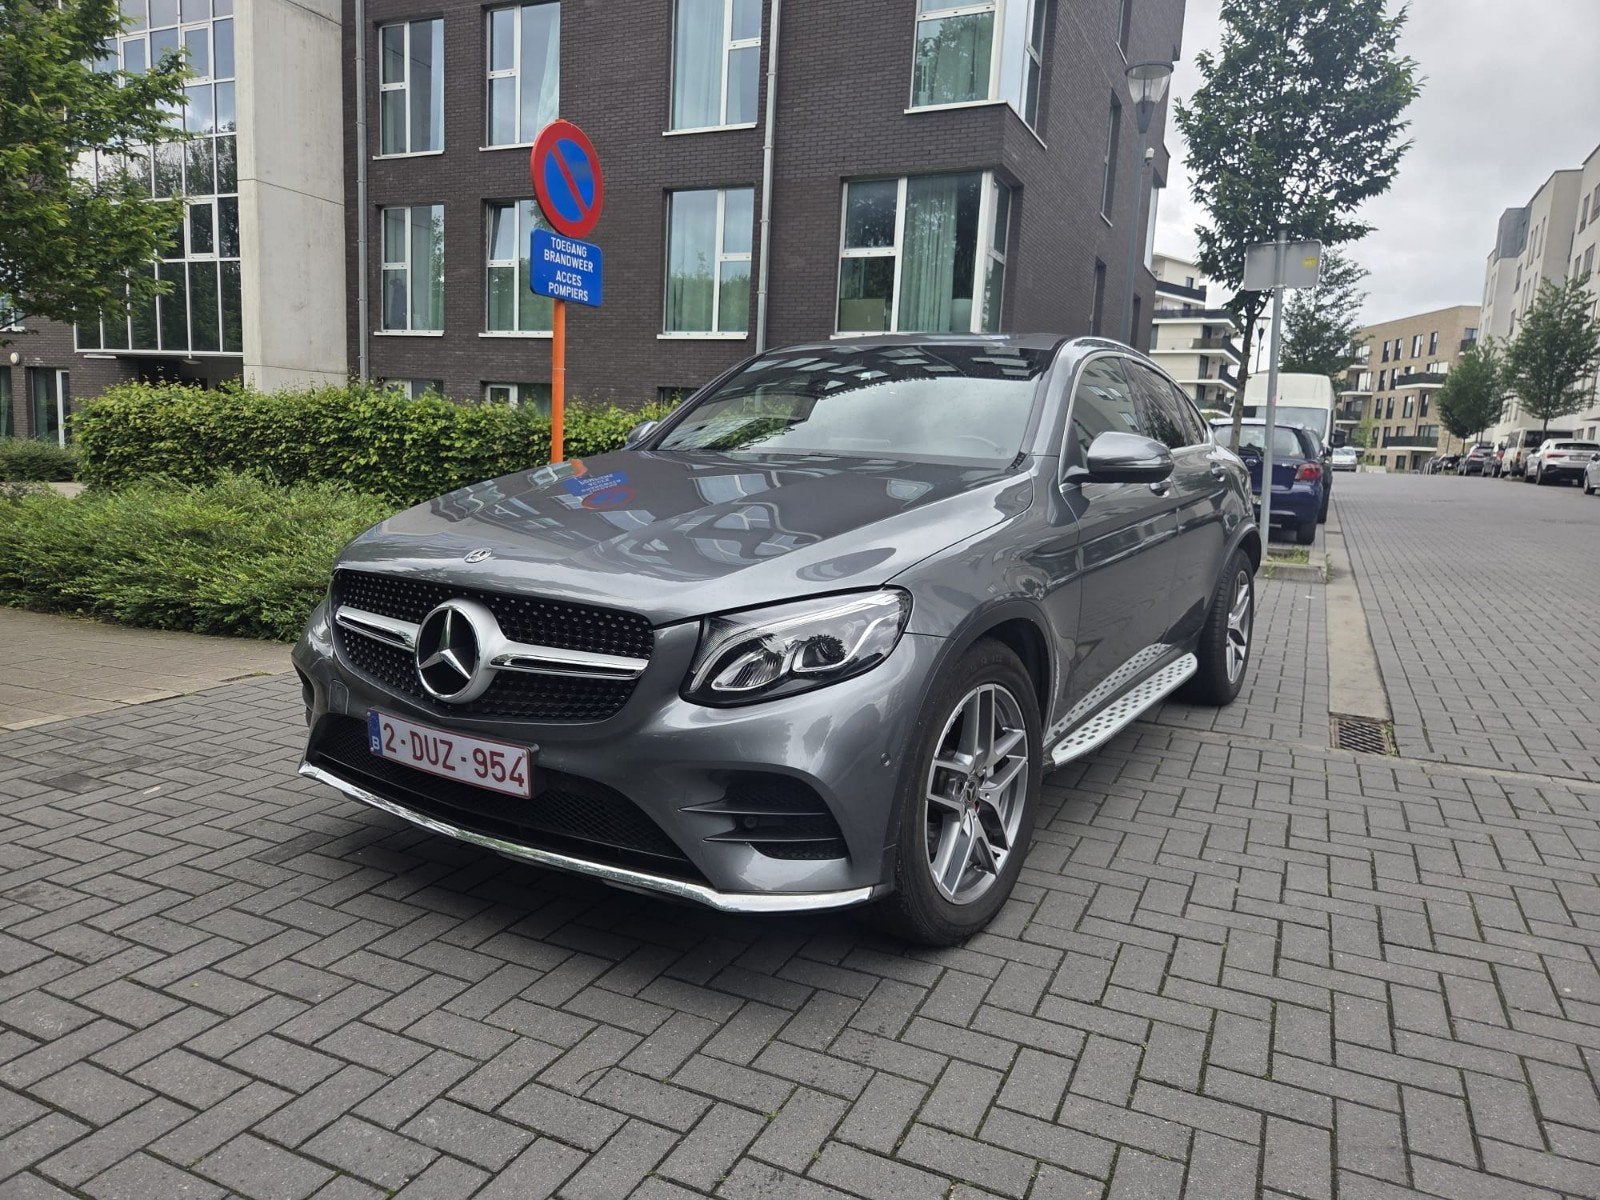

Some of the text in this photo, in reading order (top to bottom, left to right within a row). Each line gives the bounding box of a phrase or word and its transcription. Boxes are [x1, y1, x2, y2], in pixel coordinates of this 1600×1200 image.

[551, 237, 587, 258] TOEGANG
[544, 249, 594, 273] BRANDWEER
[556, 270, 582, 287] ACCES
[548, 282, 589, 302] POMPIERS
[372, 735, 380, 750] B
[383, 722, 525, 788] 2-DUZ-954
